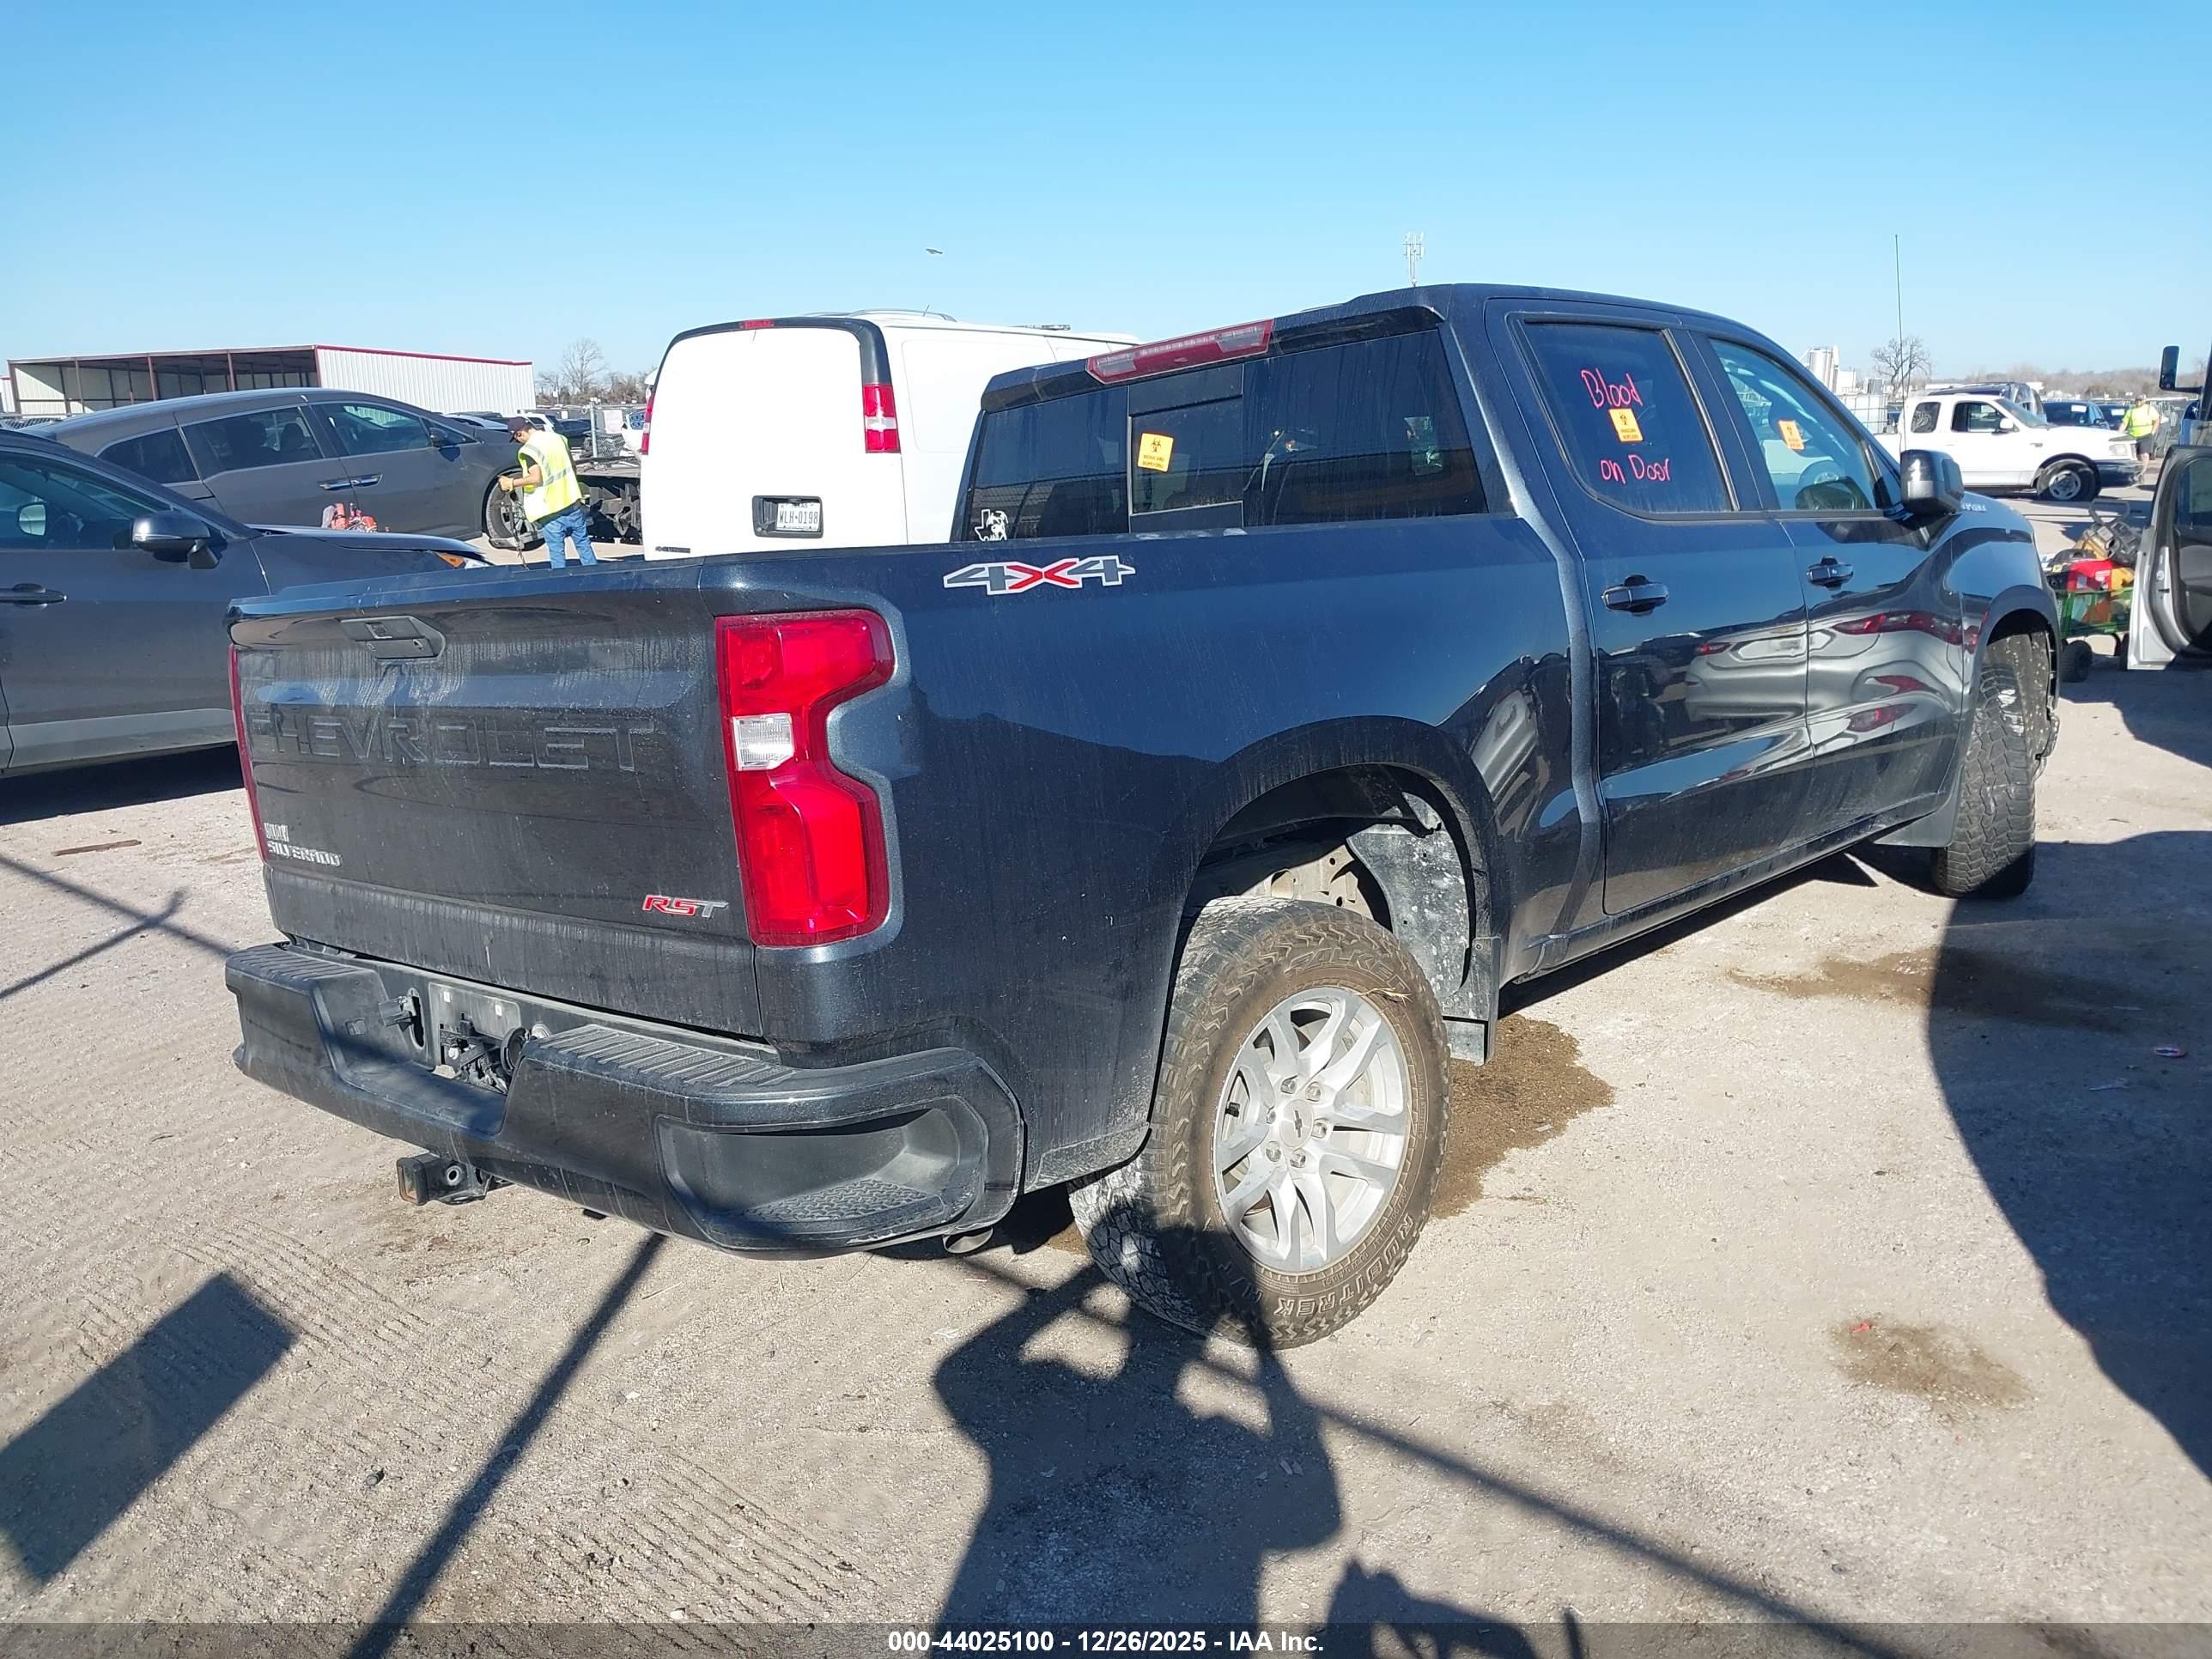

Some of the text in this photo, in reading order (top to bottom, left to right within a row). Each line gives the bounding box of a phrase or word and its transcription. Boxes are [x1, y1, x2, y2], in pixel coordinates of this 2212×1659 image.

[1581, 368, 1644, 409] Blood
[1601, 454, 1671, 485] on Door
[267, 841, 342, 867] SILVERADO
[642, 894, 729, 918] RST
[1273, 1212, 1415, 1318] RUBITREK
